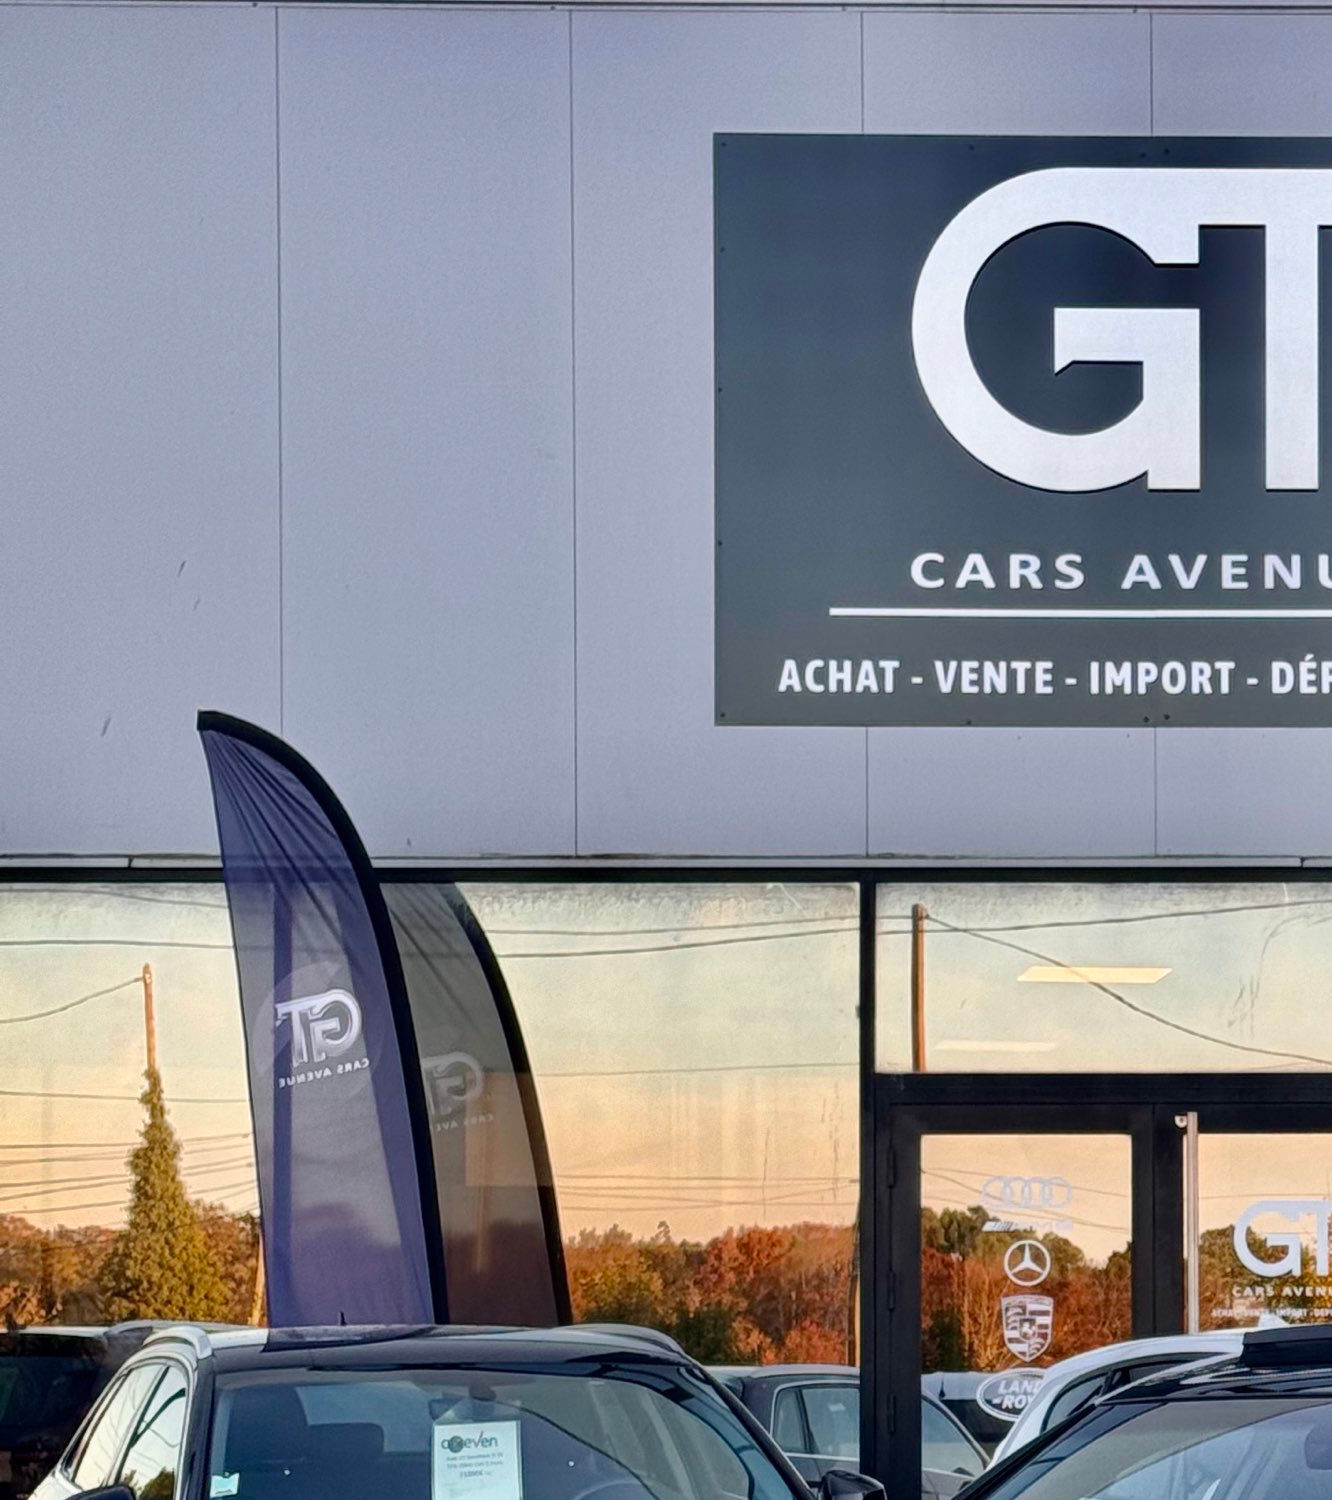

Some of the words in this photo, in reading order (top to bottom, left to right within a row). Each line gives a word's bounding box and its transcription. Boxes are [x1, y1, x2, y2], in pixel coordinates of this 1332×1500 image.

[911, 553, 1084, 589] CARS
[778, 659, 899, 693] ACHAT
[935, 661, 1053, 693] VENTE
[1091, 661, 1235, 694] IMPORT
[1231, 1285, 1275, 1297] CARS
